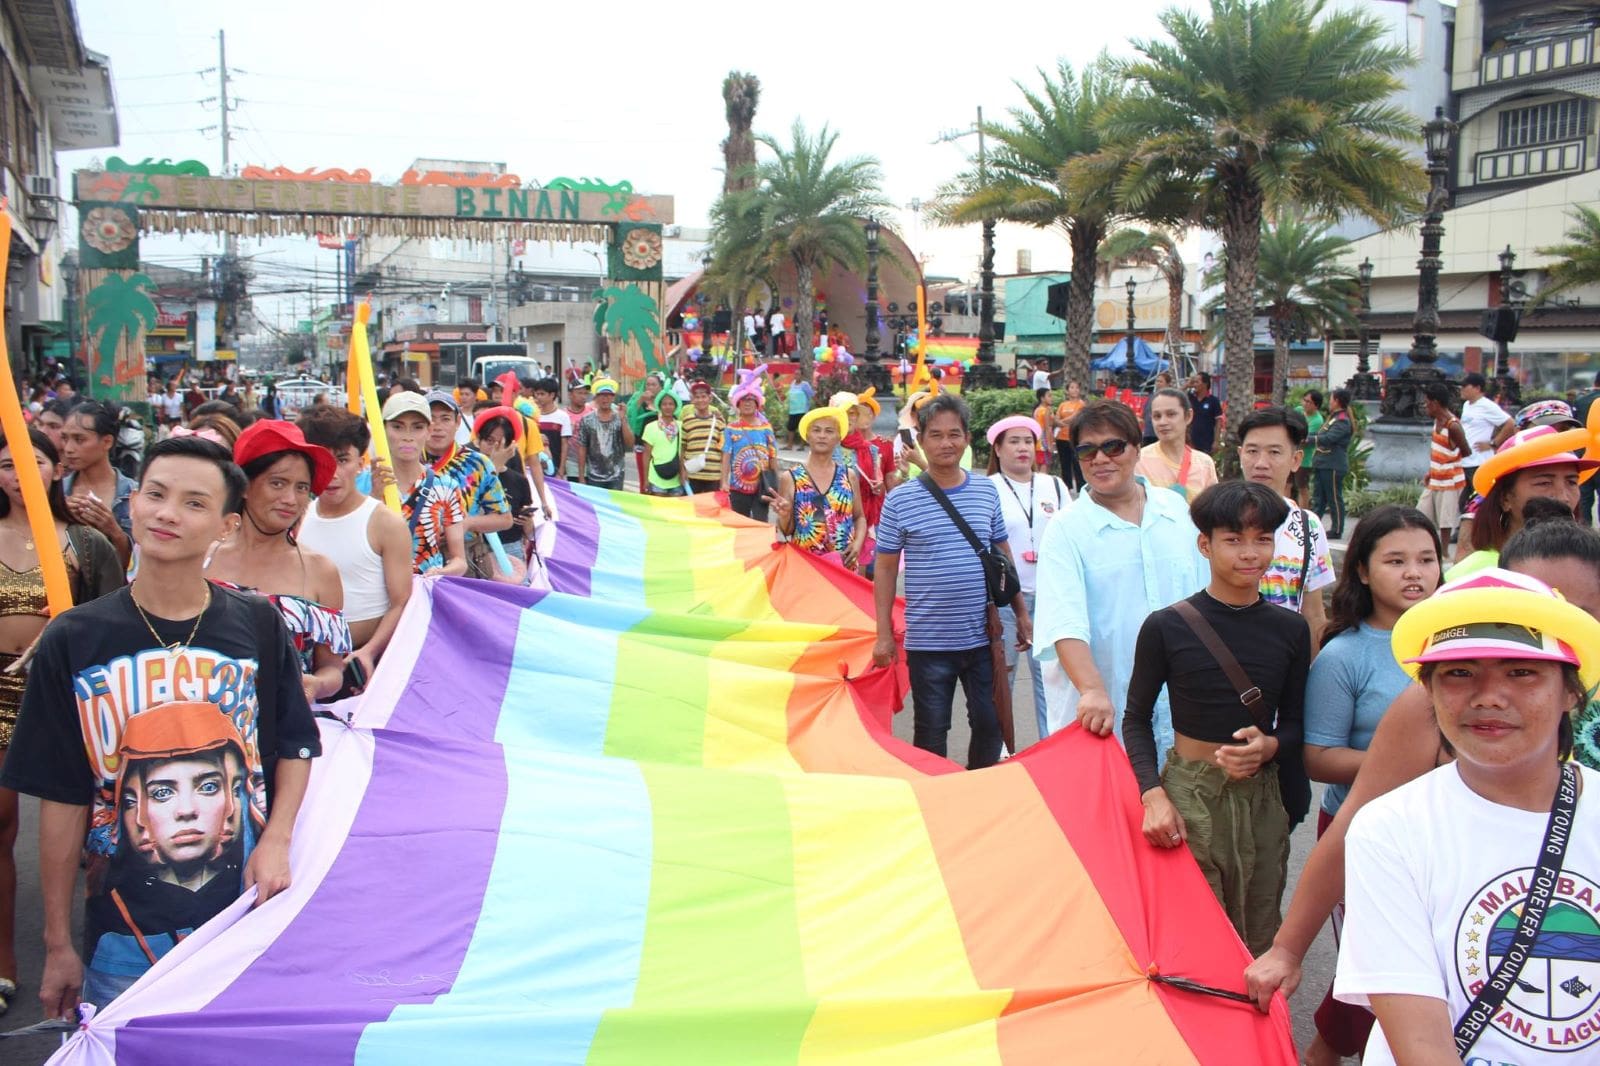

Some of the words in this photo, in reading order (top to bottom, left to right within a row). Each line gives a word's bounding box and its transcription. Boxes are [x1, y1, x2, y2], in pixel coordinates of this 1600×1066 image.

[177, 180, 421, 214] EXPERIENCE
[1546, 808, 1572, 855] YOUNG
[1478, 876, 1600, 915] MALBA
[1519, 866, 1555, 938] FOREVER
[1491, 943, 1529, 991] YOUNG
